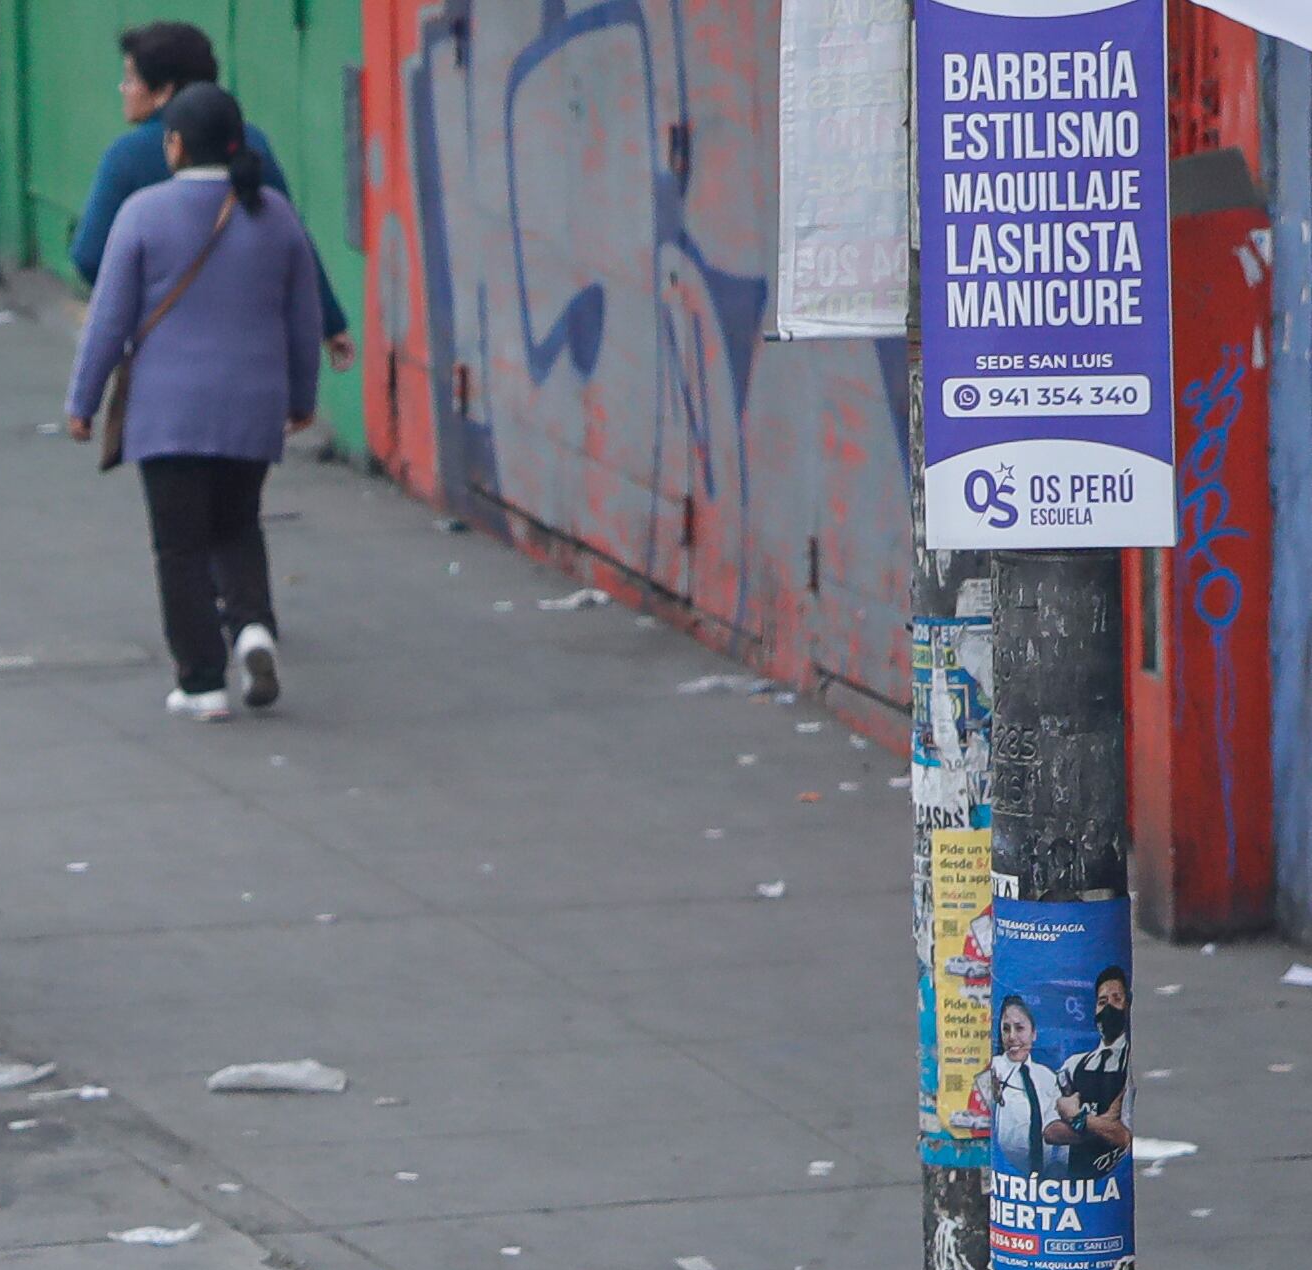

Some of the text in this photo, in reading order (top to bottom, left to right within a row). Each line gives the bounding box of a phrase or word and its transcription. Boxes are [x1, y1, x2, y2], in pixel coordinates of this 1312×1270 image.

[943, 40, 1138, 102] BARBERÍA
[943, 110, 1140, 161] ESTILISMO
[944, 169, 1141, 215] MAQUILLAJE
[946, 221, 1142, 275] LASHISTA
[946, 278, 1143, 328] MANICURE
[976, 353, 1114, 370] SEDE SAN LUIS
[988, 386, 1138, 406] 941 354 340
[1030, 468, 1134, 504] OS PERÚ
[1030, 507, 1093, 526] ESCUELA
[940, 844, 964, 855] Pide
[967, 845, 982, 855] un
[940, 857, 973, 869] desde
[940, 875, 954, 883] en
[956, 873, 967, 883] la
[1038, 923, 1050, 932] LA
[1052, 923, 1086, 933] MAGIA
[944, 1013, 977, 1024] desde
[990, 1169, 1121, 1204] ATRÍCULA
[990, 1195, 1082, 1232] BIERTA
[1011, 1237, 1034, 1250] 340
[1050, 1241, 1075, 1251] SEDE
[1083, 1240, 1102, 1251] SAN
[1034, 1260, 1089, 1270] MAQUILLAJE
